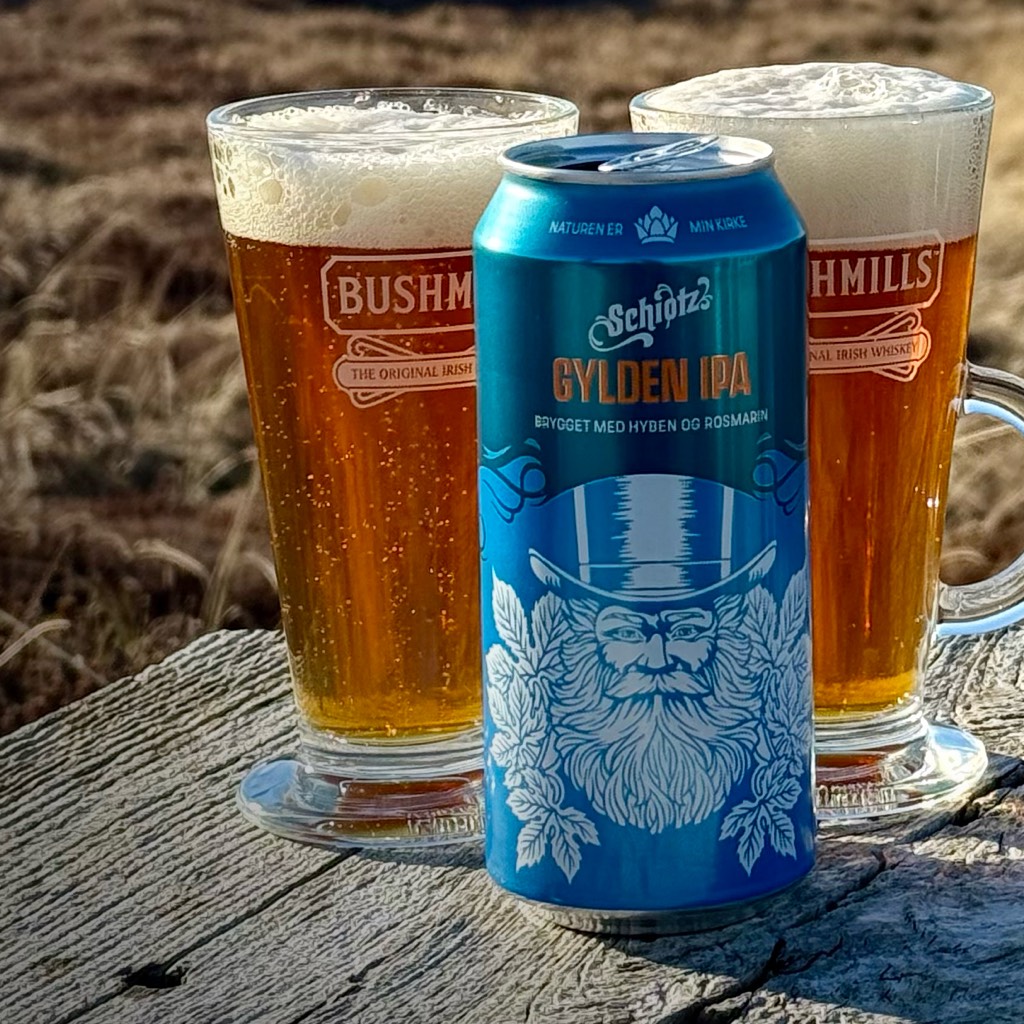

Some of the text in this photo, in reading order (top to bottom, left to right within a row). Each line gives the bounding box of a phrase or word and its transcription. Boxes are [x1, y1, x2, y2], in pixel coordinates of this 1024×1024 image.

[549, 215, 748, 236] NATUREN ER MIN KIRKE
[837, 348, 867, 361] IRISH
[871, 341, 918, 358] WHISKEY
[351, 362, 473, 381] THE ORIGINAL IRISH
[553, 351, 752, 404] GYLDEN IPA
[534, 409, 769, 434] BRYGGET MED HYBEN OG ROSMARIN
